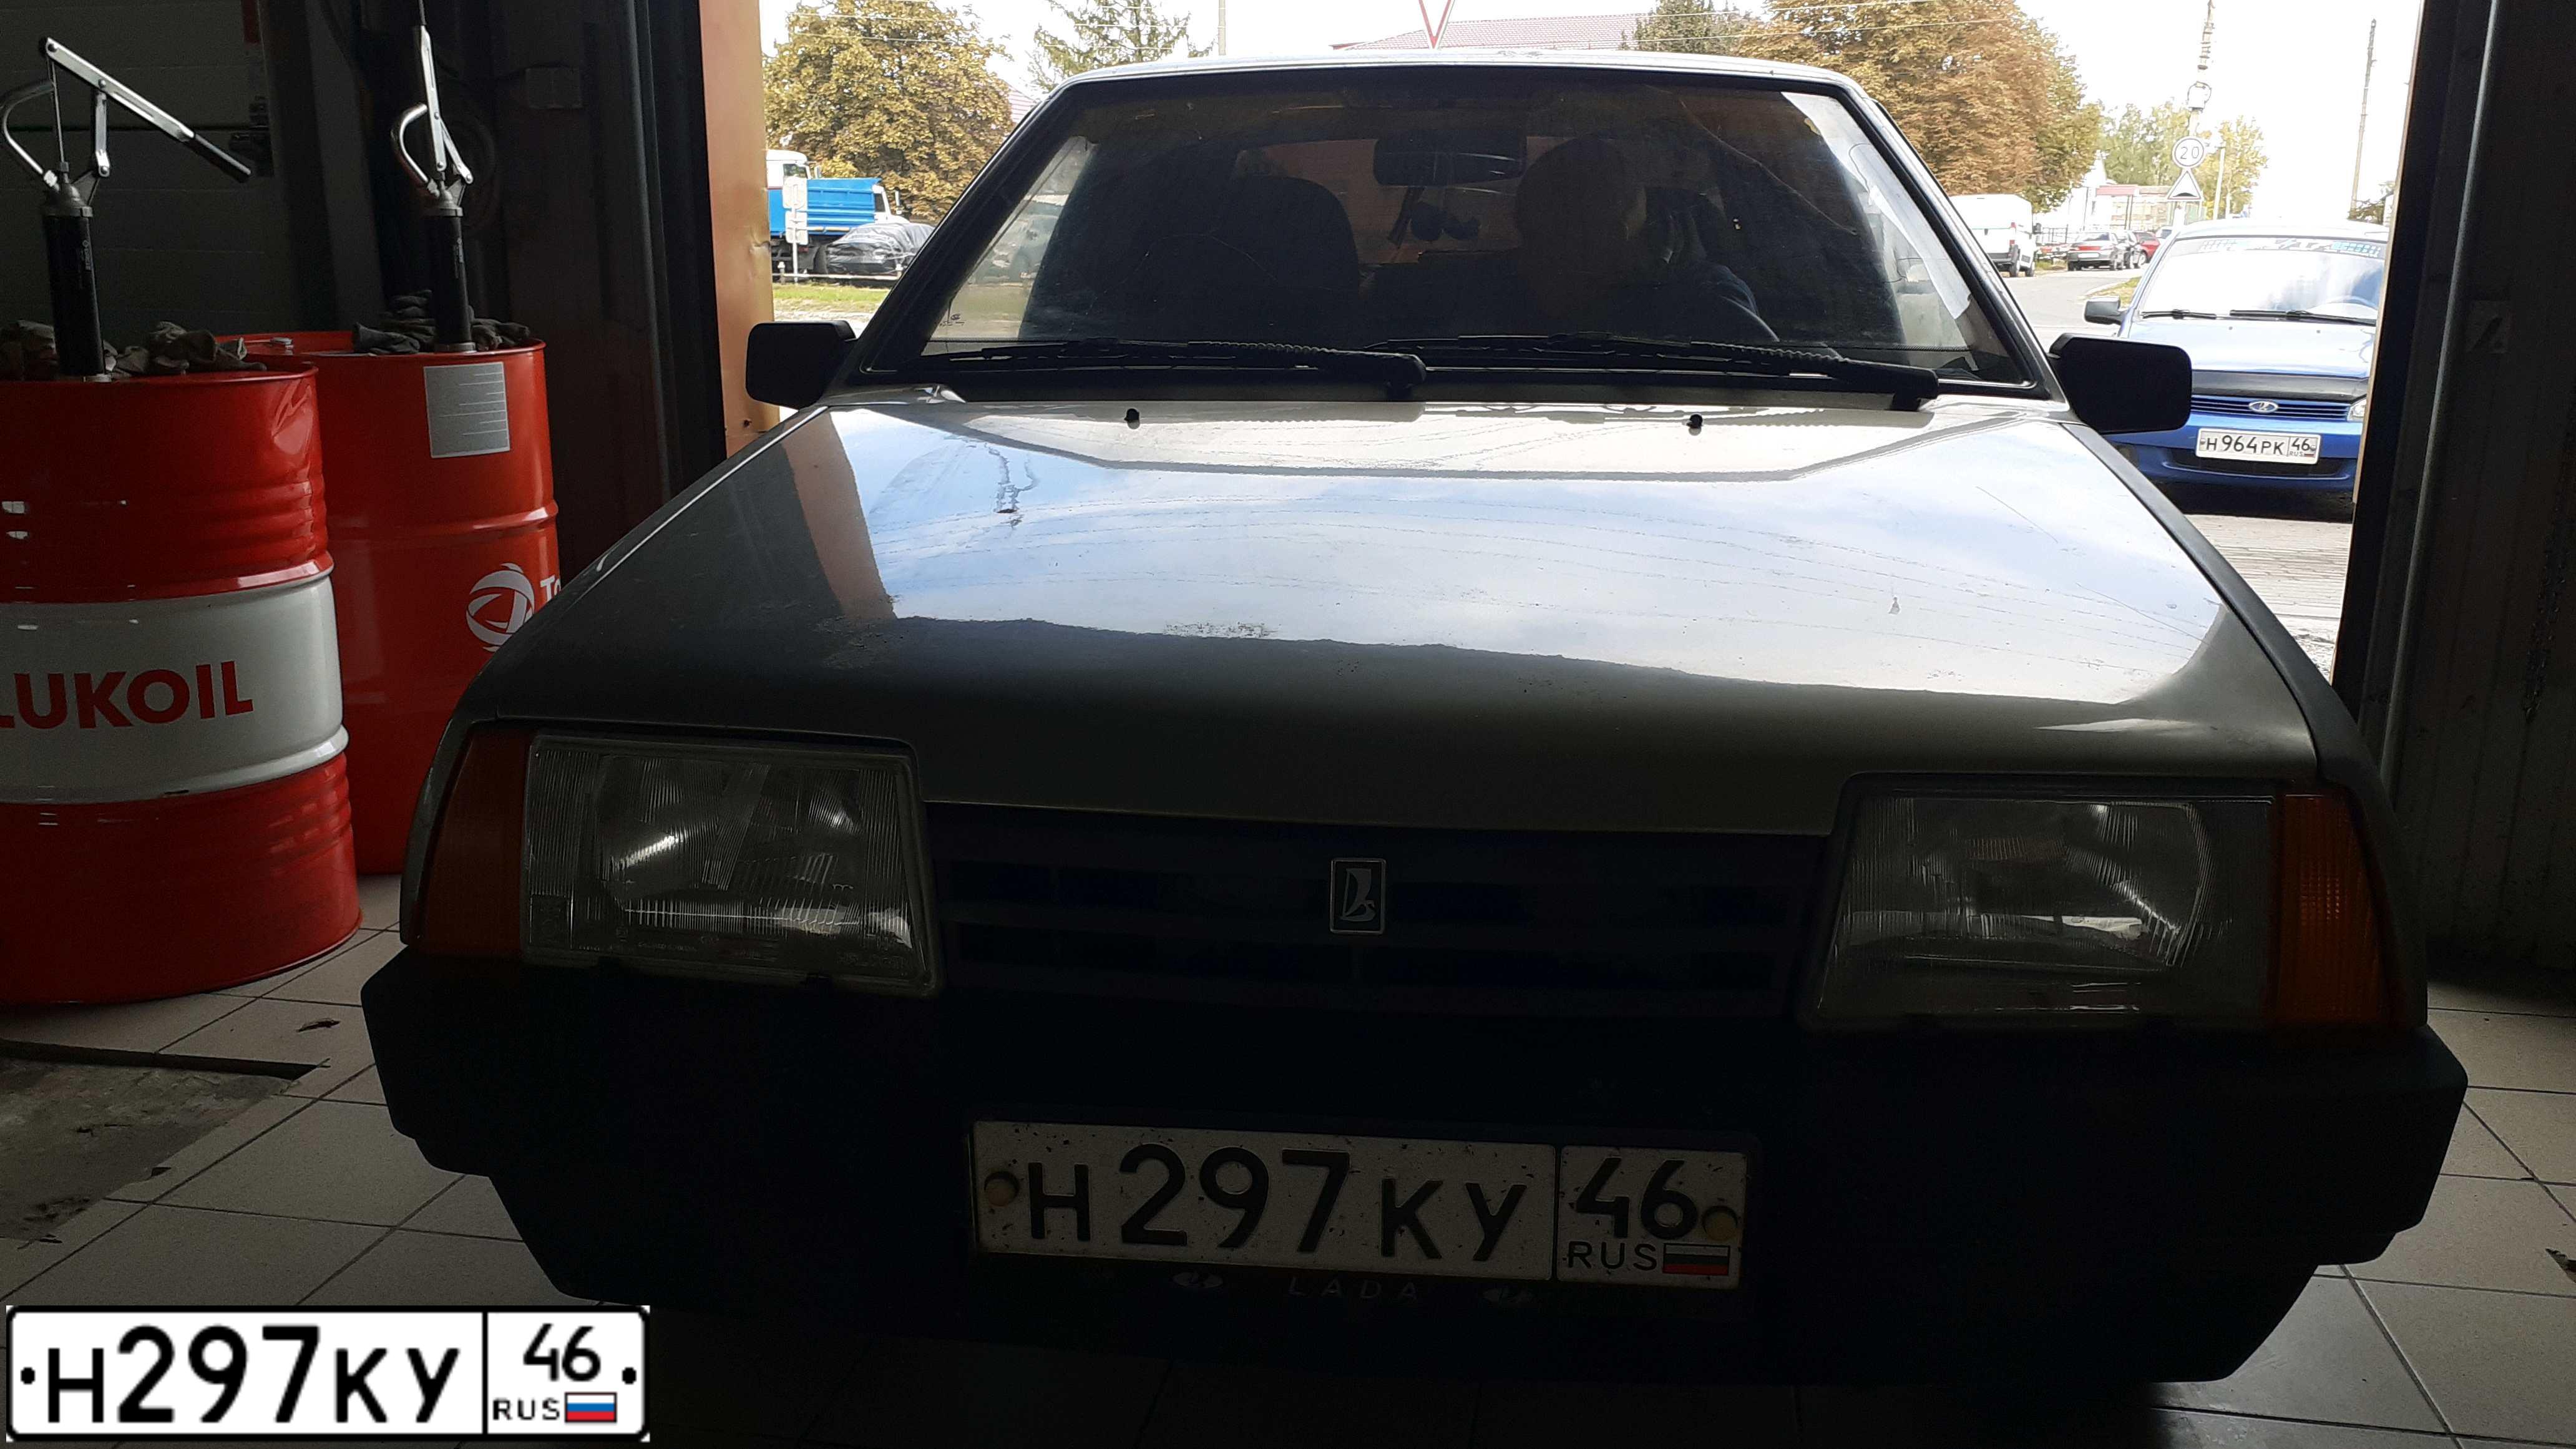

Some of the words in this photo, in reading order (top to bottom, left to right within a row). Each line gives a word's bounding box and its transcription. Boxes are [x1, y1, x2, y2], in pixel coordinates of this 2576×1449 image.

[2180, 146, 2200, 160] 20
[2291, 437, 2311, 451] 46
[1576, 1156, 1699, 1239] 46
[1566, 1240, 1659, 1271] RUS
[1287, 1276, 1420, 1302] LADA
